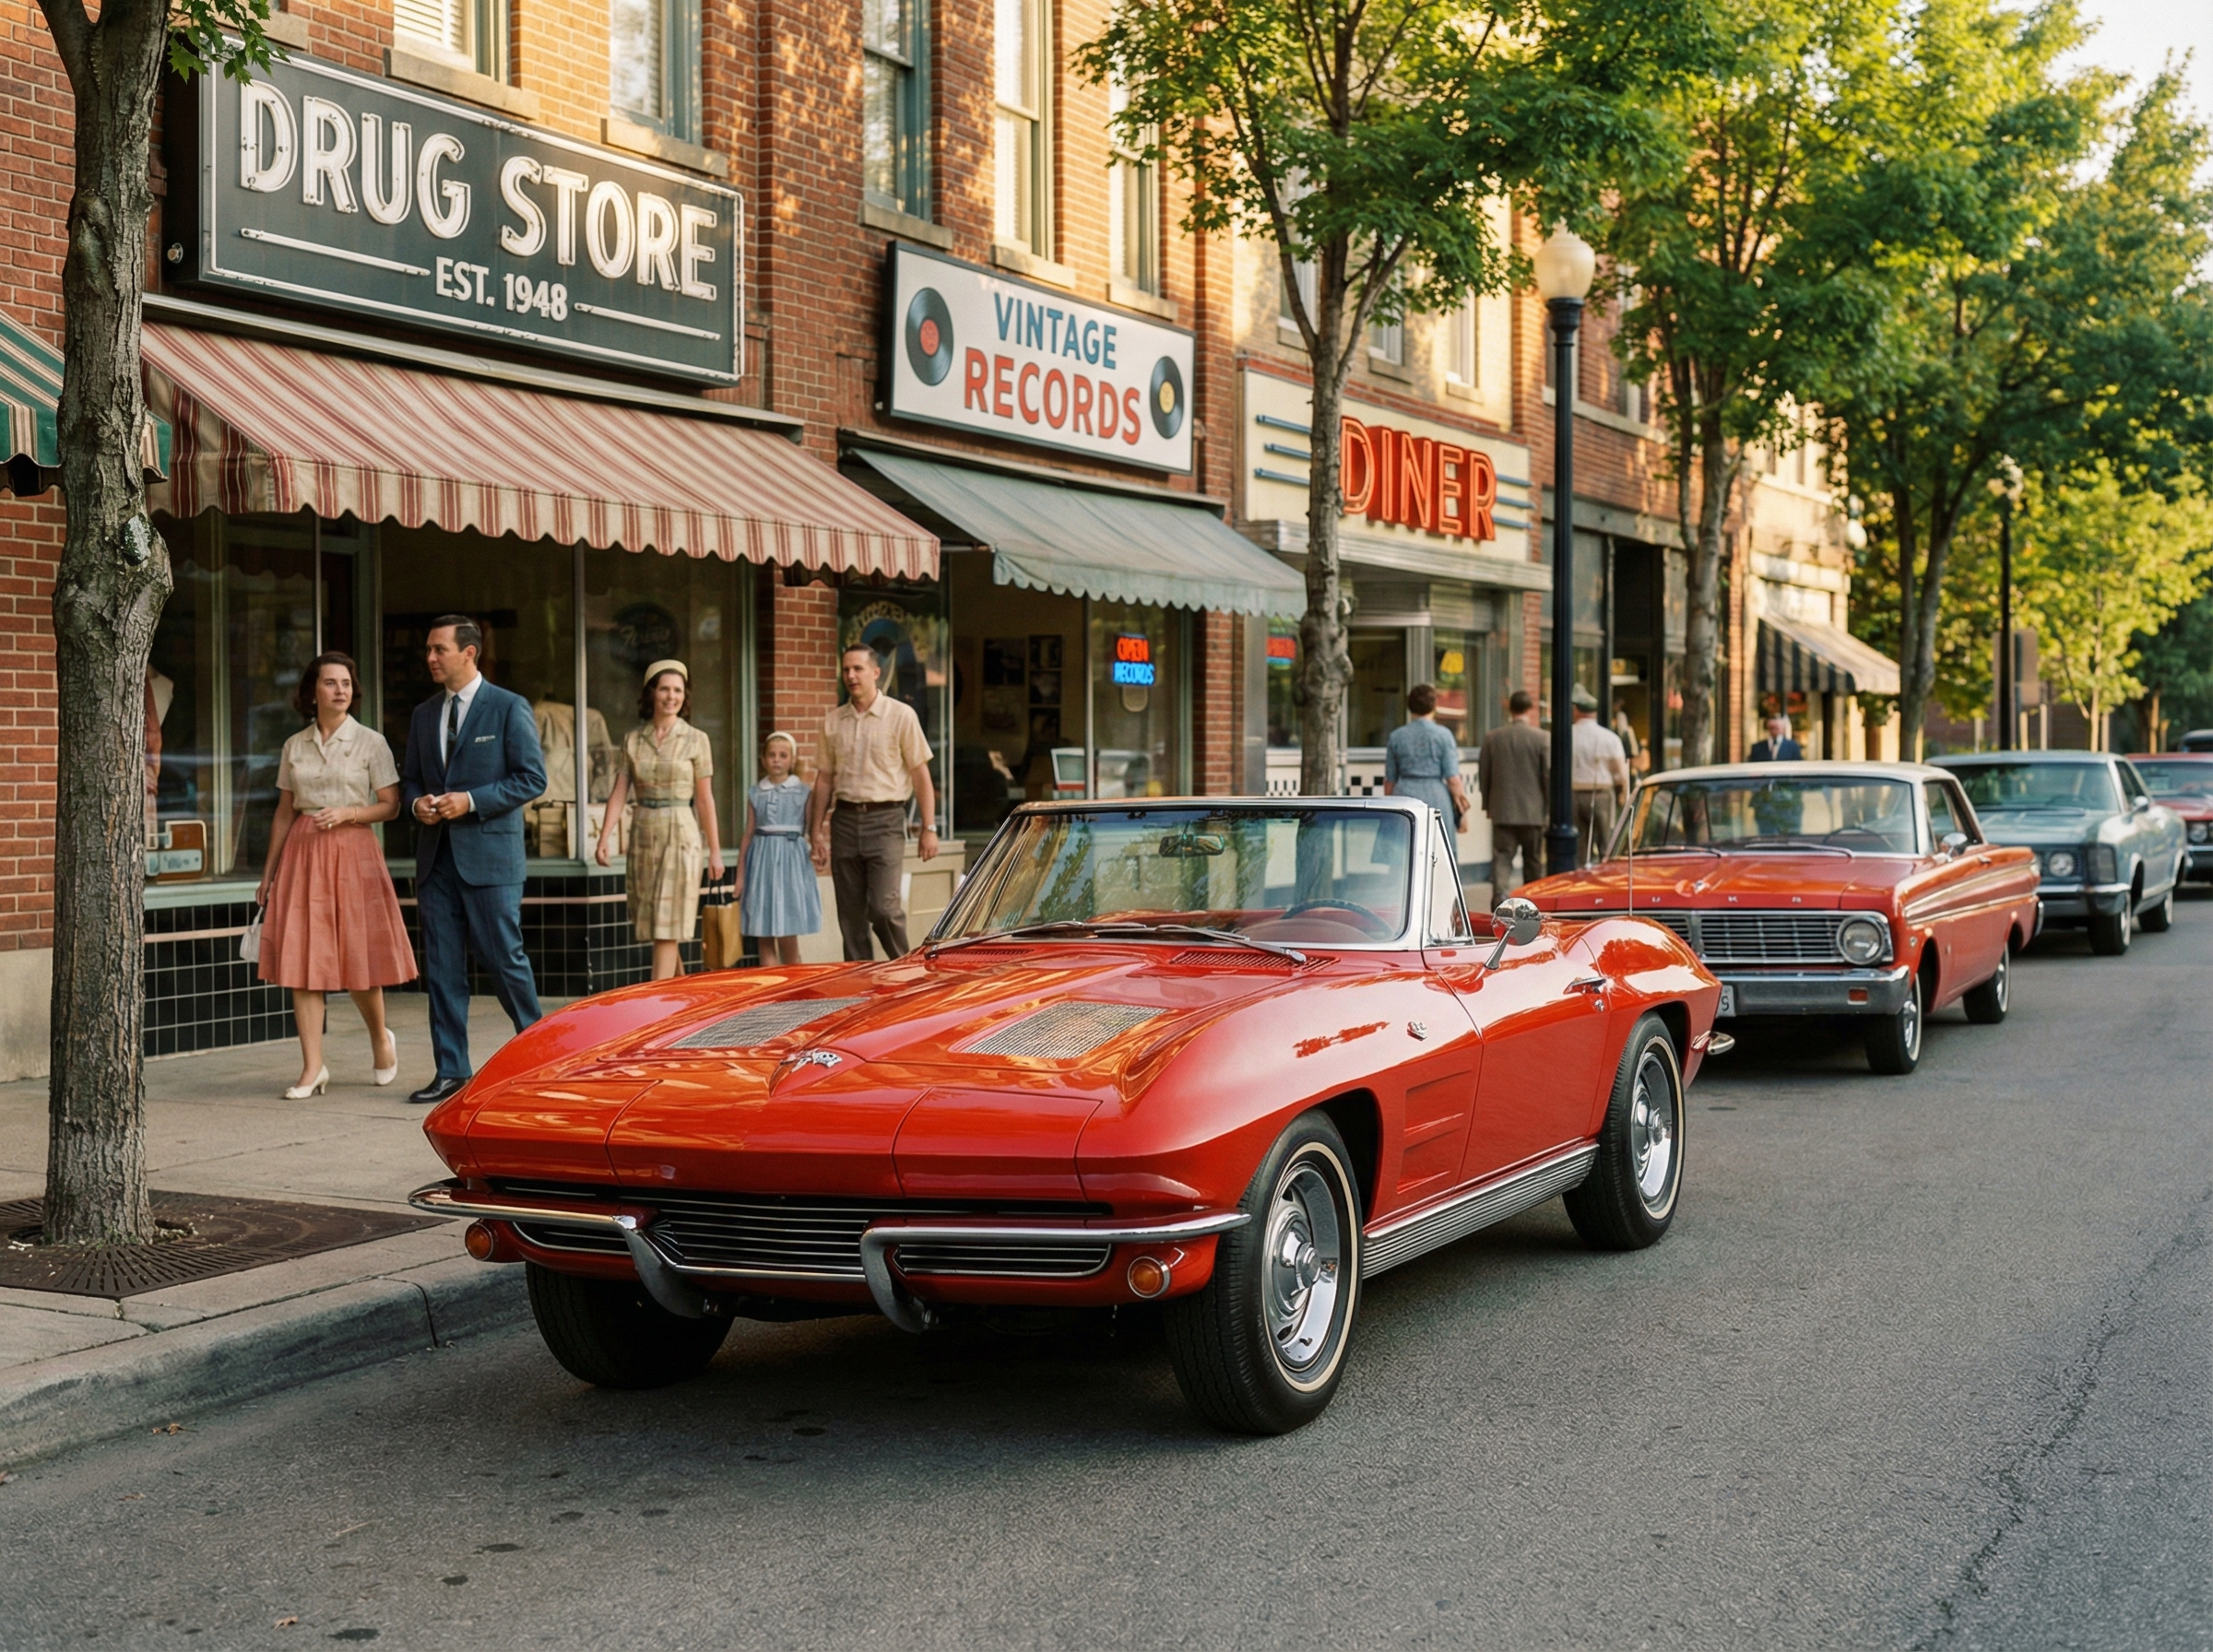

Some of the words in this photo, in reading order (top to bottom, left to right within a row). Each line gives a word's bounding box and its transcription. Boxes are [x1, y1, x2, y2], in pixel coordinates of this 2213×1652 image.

[240, 79, 471, 240] DRUG
[500, 156, 718, 301] STORE
[436, 256, 495, 307] EST.
[503, 273, 568, 322] 1948
[994, 292, 1117, 370] VINTAGE
[964, 347, 1141, 446] RECORDS
[1340, 415, 1497, 542] DINER
